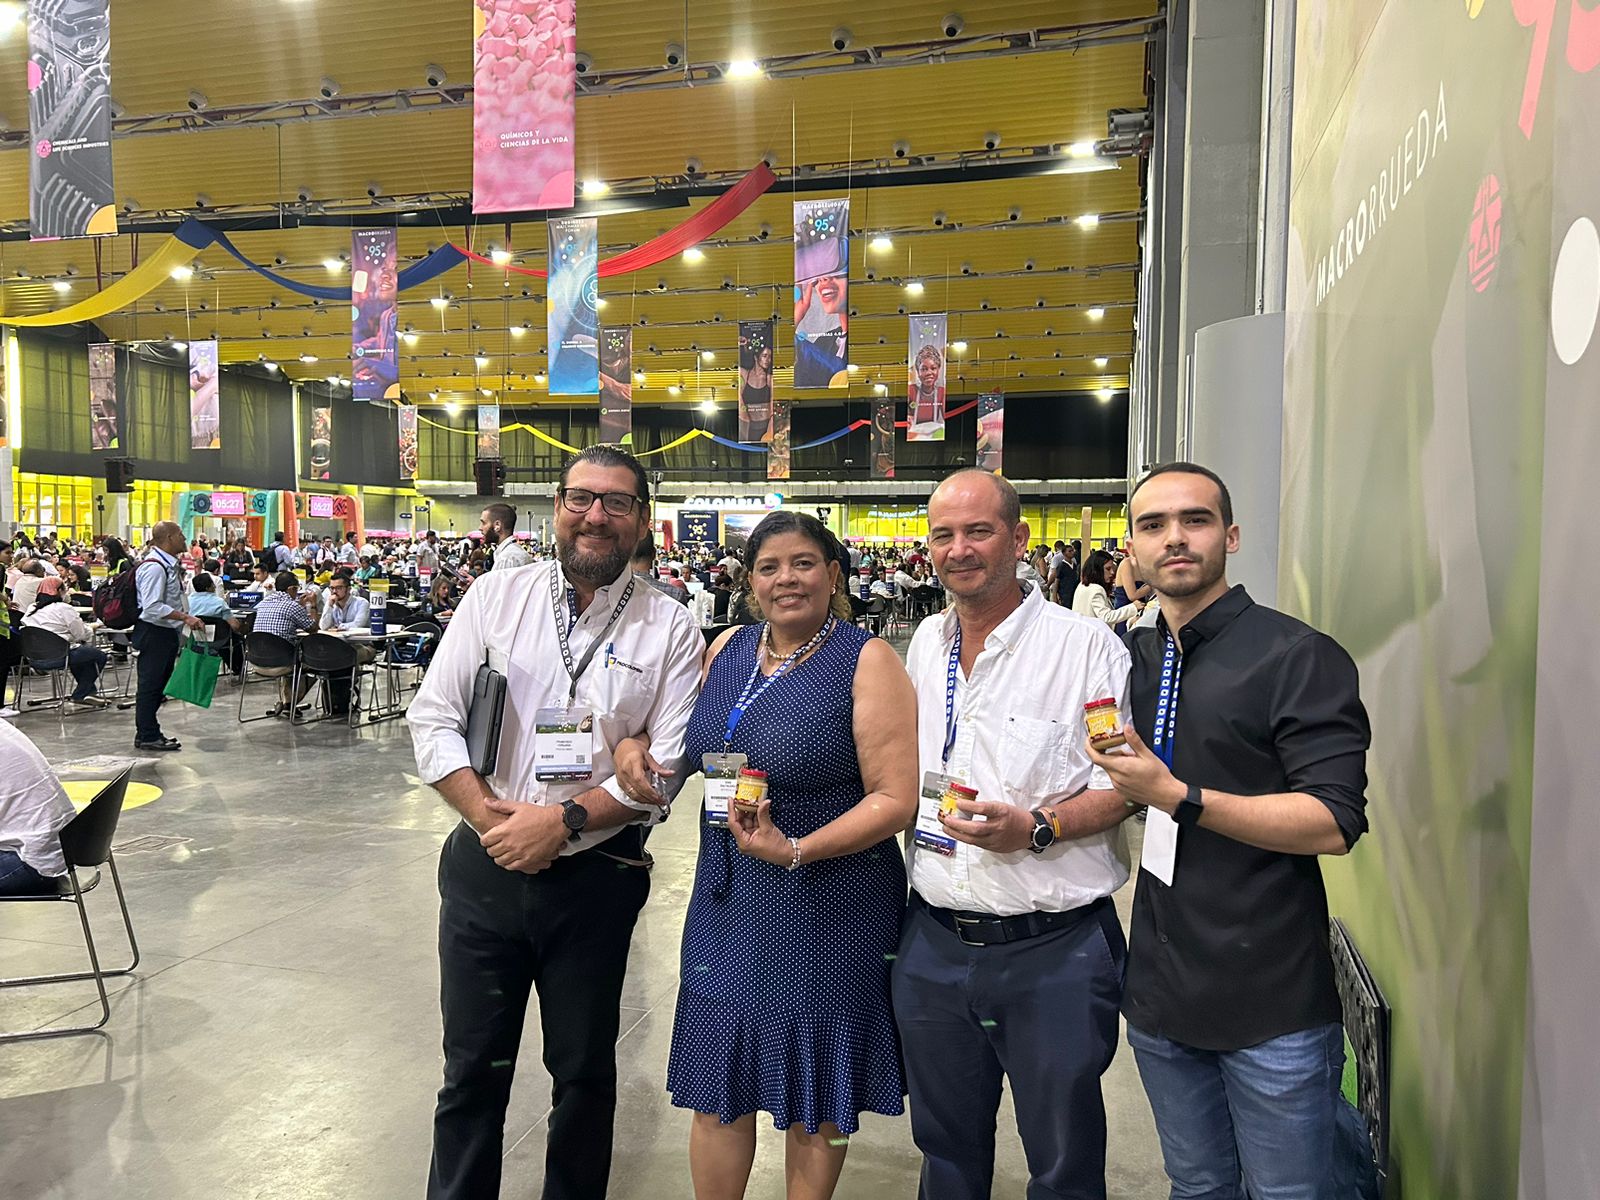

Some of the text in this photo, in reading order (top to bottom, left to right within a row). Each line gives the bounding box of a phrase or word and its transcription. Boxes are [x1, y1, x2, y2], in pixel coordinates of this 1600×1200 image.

[500, 129, 541, 140] QUÍMICOS Y
[500, 140, 530, 149] CIENCIAS
[552, 136, 569, 144] VIDA
[1316, 80, 1448, 307] MACRORRUEDA
[814, 219, 829, 232] 95
[369, 245, 381, 257] 95
[611, 338, 621, 347] 95
[215, 499, 240, 509] 05:27
